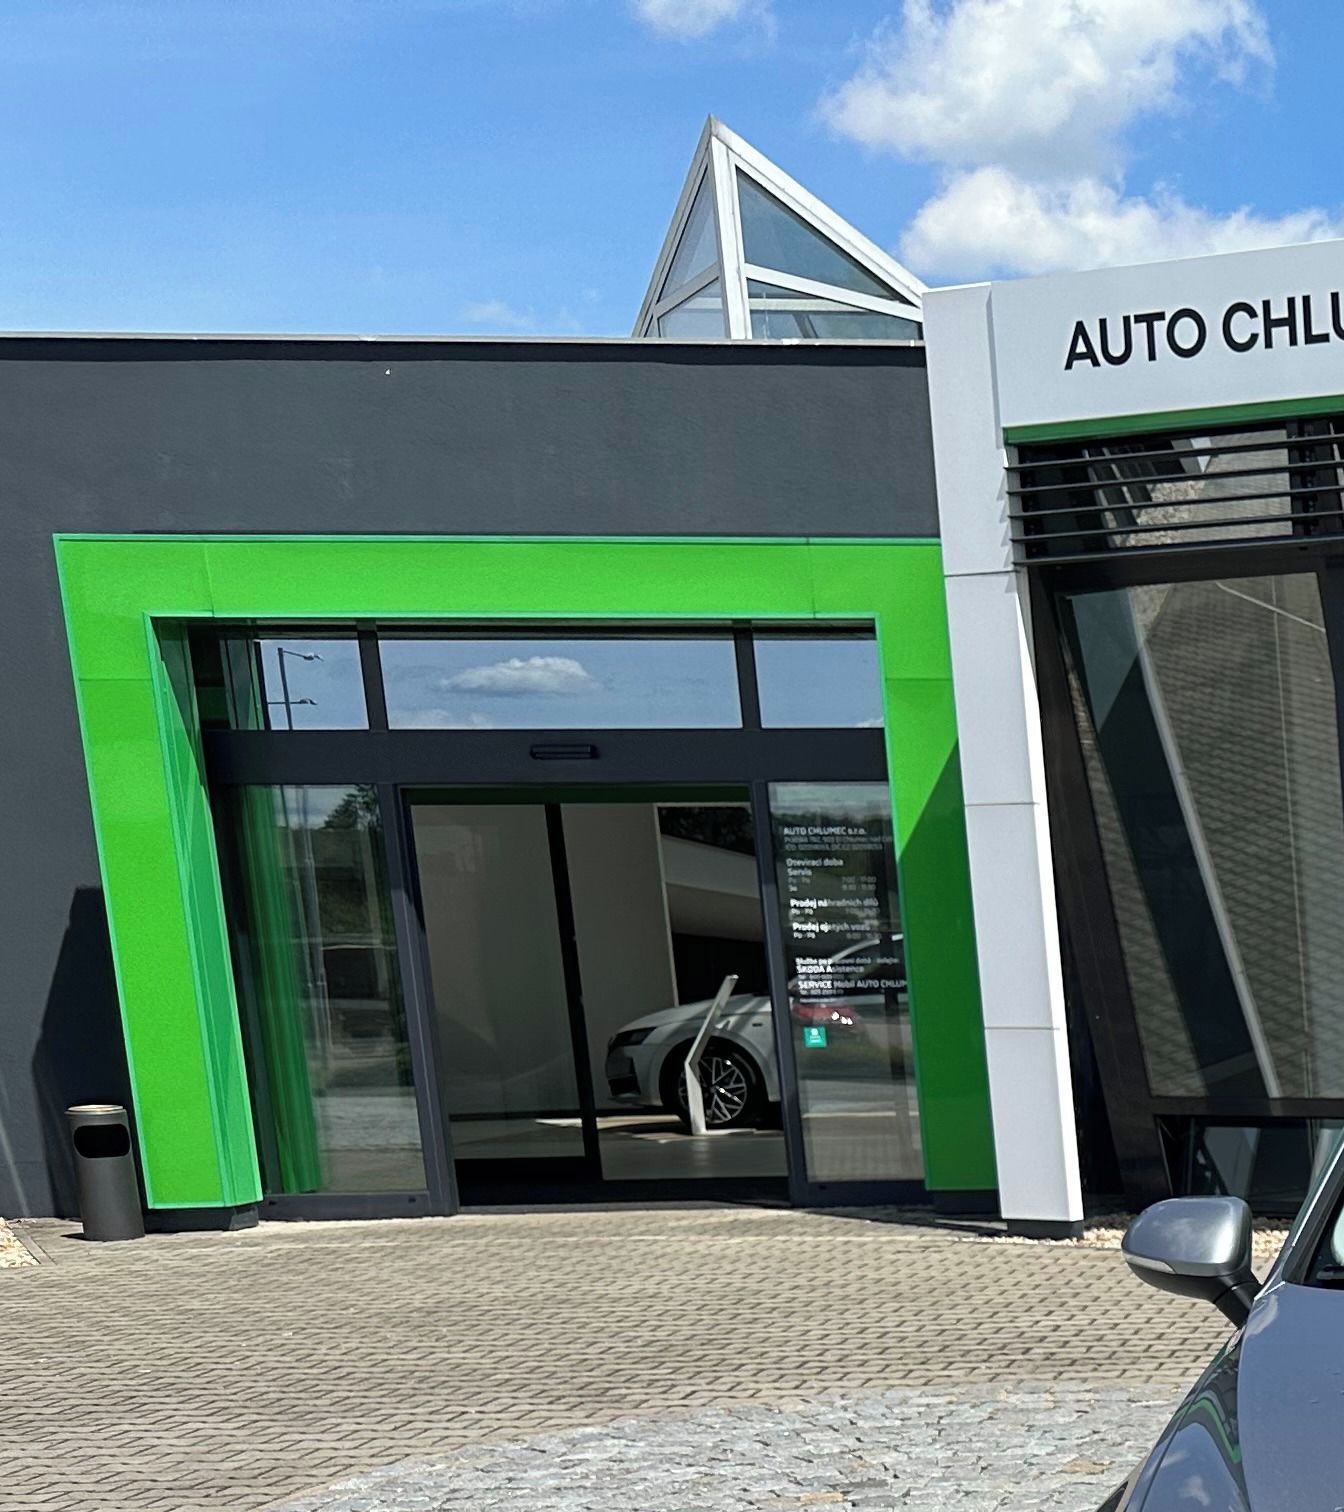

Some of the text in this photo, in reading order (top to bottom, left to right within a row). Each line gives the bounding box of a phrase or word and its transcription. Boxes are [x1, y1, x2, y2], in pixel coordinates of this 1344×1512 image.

[1064, 308, 1207, 371] AUTO
[783, 826, 806, 835] AUTO
[808, 826, 847, 835] CHLUMEC
[790, 898, 817, 909] Prodej
[792, 922, 819, 933] Prodej
[798, 980, 832, 988] SERVICE
[857, 980, 879, 988] AUTO
